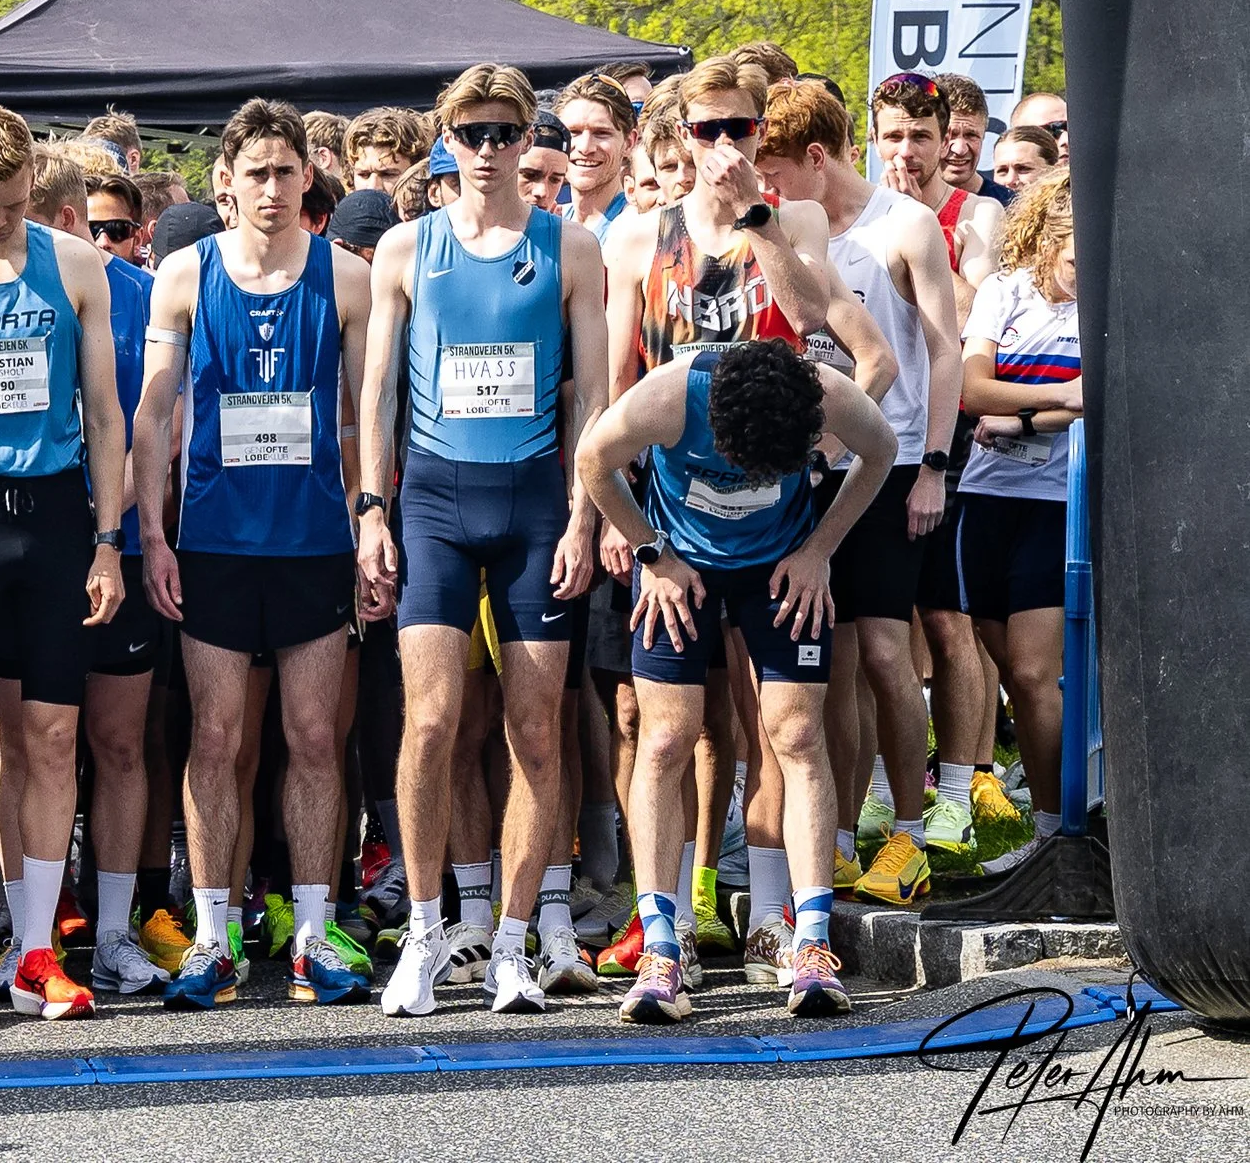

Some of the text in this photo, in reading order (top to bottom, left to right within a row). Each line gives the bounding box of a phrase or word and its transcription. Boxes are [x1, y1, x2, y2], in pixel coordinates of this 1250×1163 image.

[17, 339, 29, 350] 5K
[450, 344, 515, 356] STRANDVEJEN 5K
[807, 338, 836, 351] NOAH
[454, 360, 516, 380] HVASS
[476, 385, 499, 396] 517
[227, 394, 292, 406] STRANDVEJEN 5K
[255, 433, 277, 443] 498
